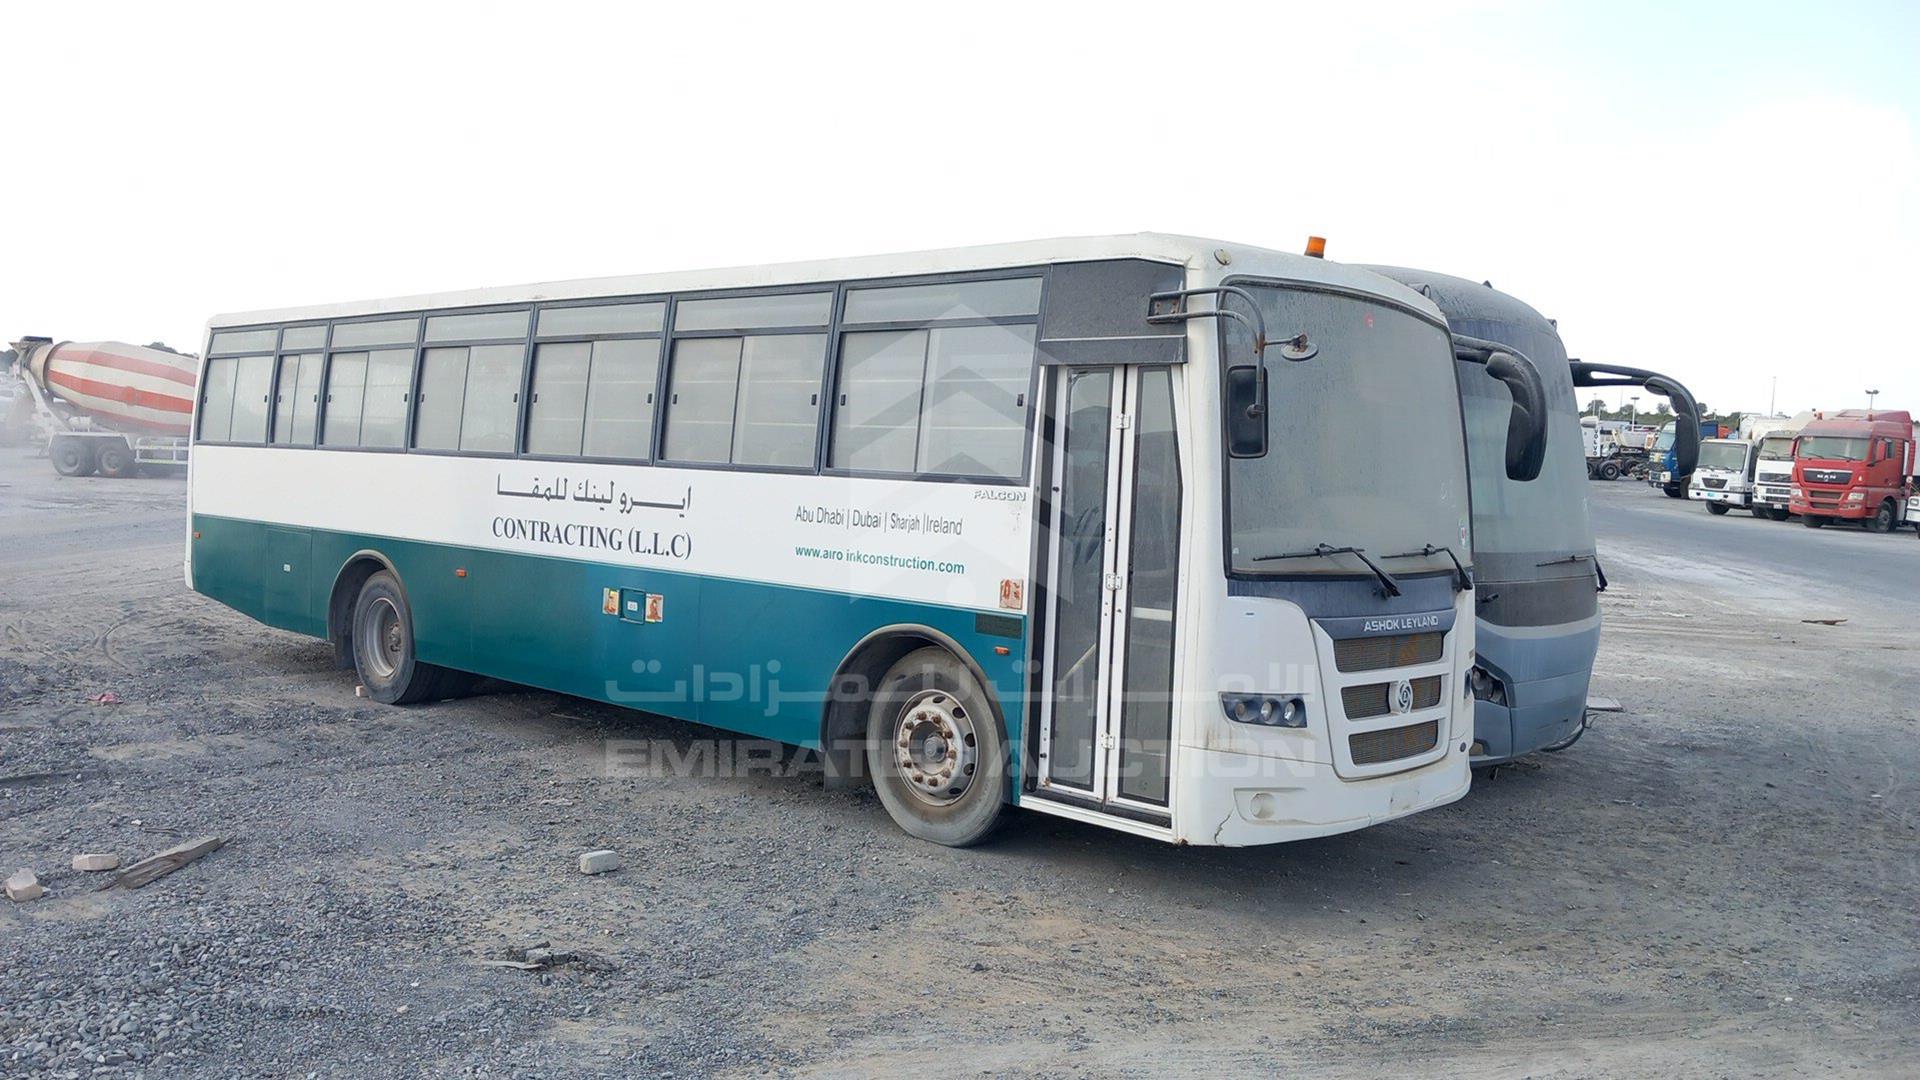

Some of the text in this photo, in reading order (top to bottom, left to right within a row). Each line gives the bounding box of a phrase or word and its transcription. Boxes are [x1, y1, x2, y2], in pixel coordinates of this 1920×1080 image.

[974, 490, 1026, 501] FALCON
[795, 505, 814, 523] Abu
[816, 507, 845, 526] Dhabi
[852, 509, 882, 529] Dubai
[890, 512, 920, 533] Sharjah
[492, 516, 692, 560] CONTRACTING (L.L.C)
[846, 549, 965, 575] inkconstruction.com
[1364, 616, 1439, 632] ASHOK LEYLAND
